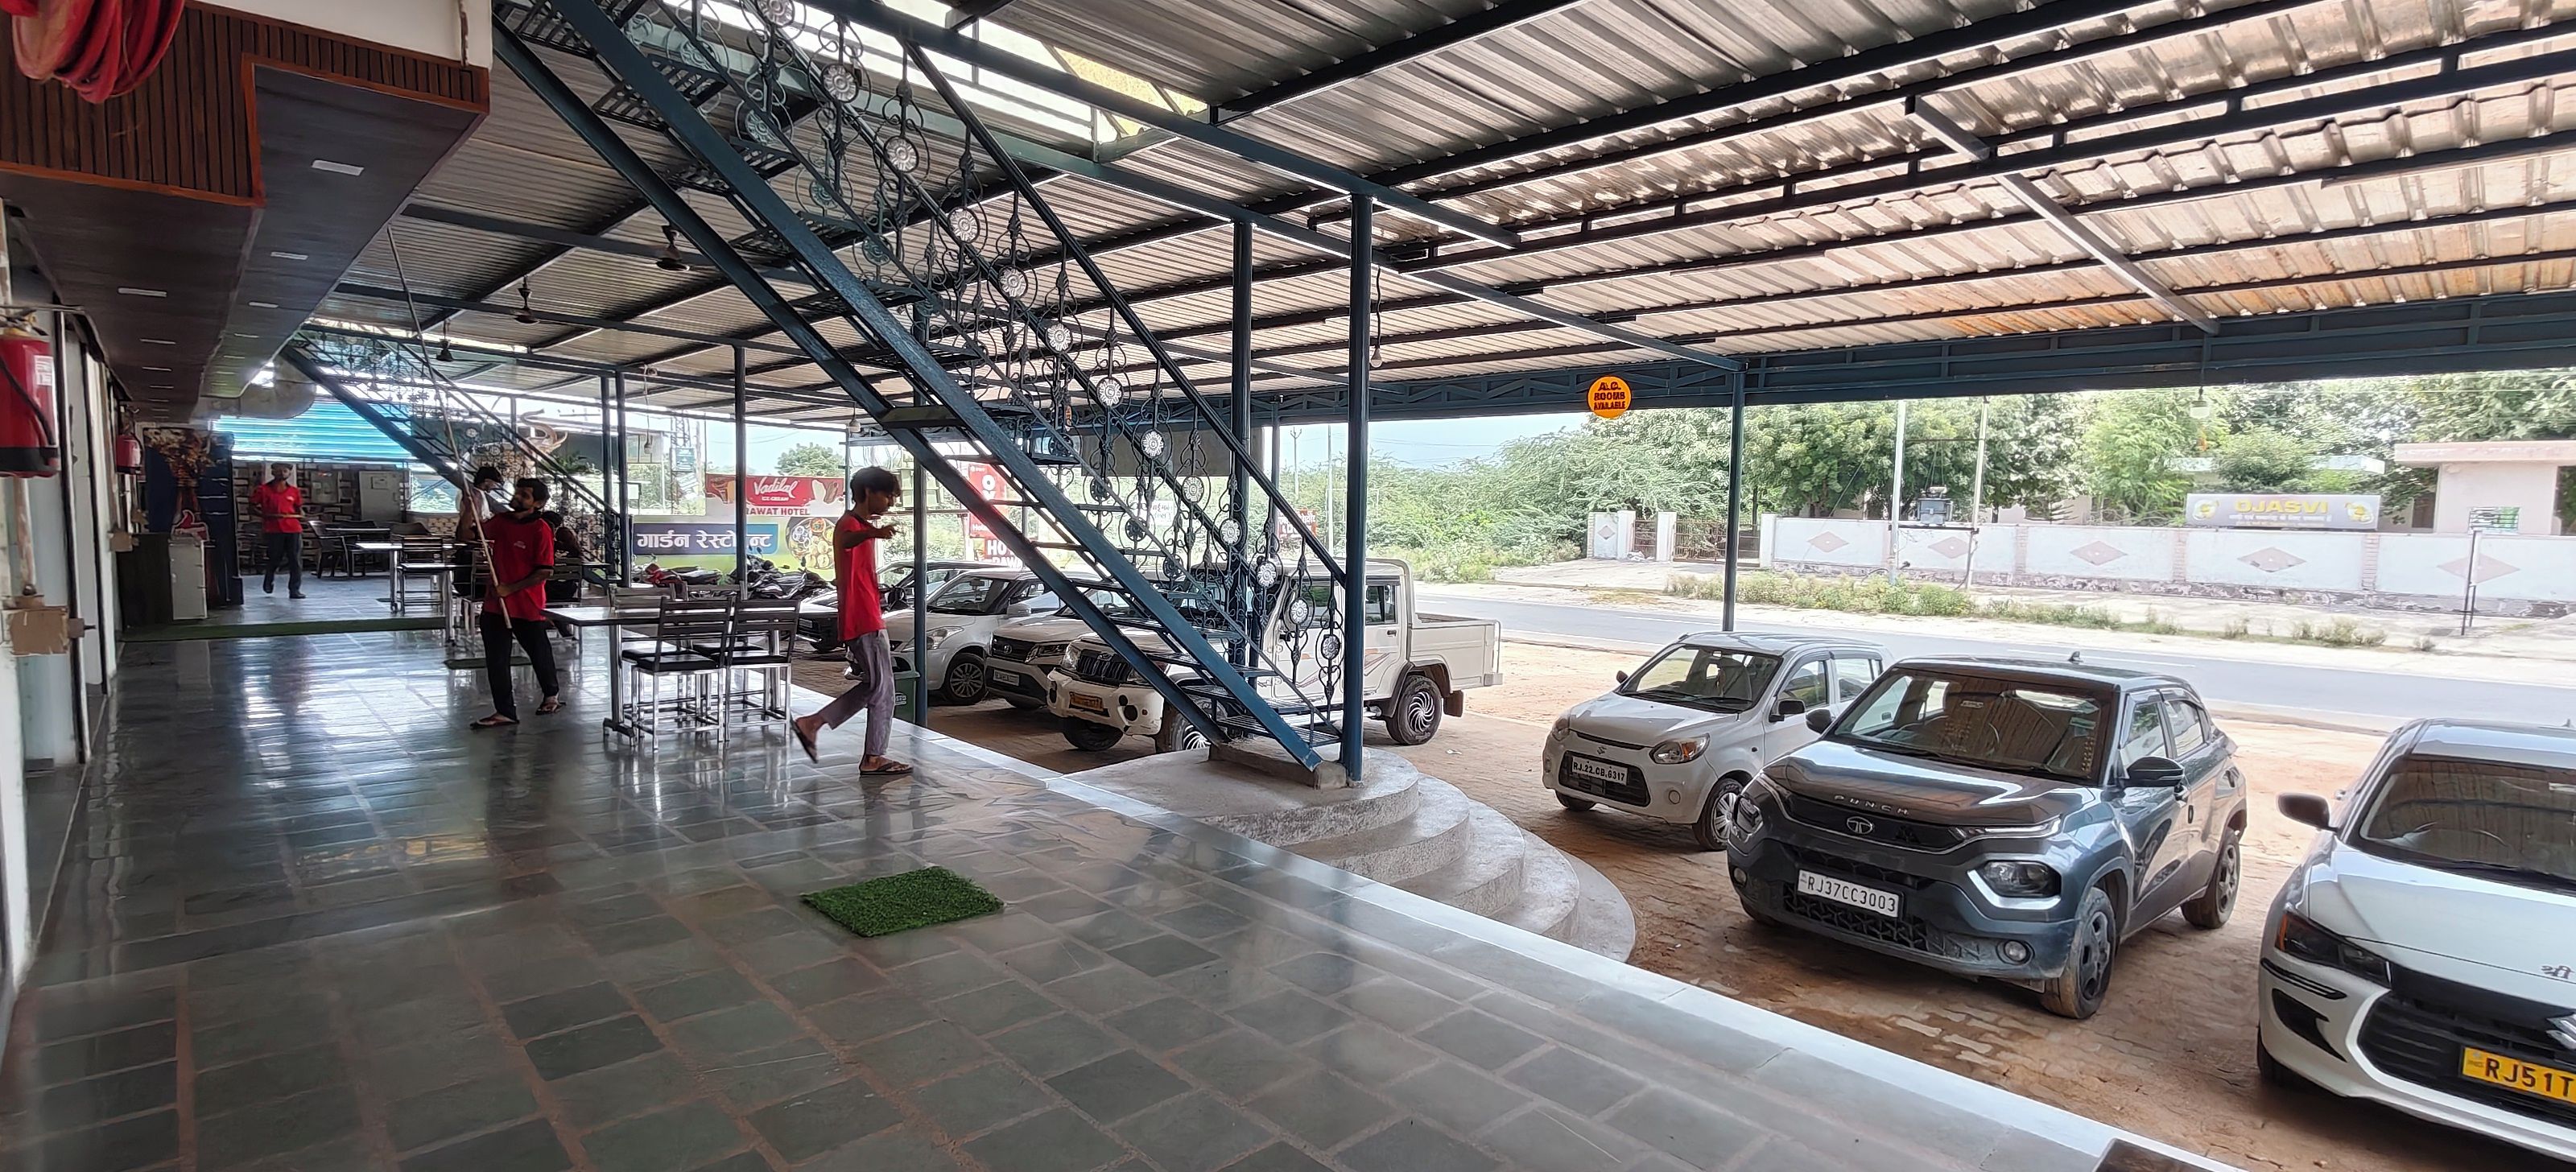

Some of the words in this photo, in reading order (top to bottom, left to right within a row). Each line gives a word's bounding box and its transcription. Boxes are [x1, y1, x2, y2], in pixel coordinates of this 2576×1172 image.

[1594, 391, 1625, 401] ROOMS
[753, 477, 799, 498] Vadilal
[781, 507, 811, 516] HOTEL
[2235, 499, 2329, 514] OJASVI
[637, 529, 691, 548] गार्डन
[1835, 794, 1909, 815] PUNCH
[1807, 876, 1896, 912] RJ37CC3003
